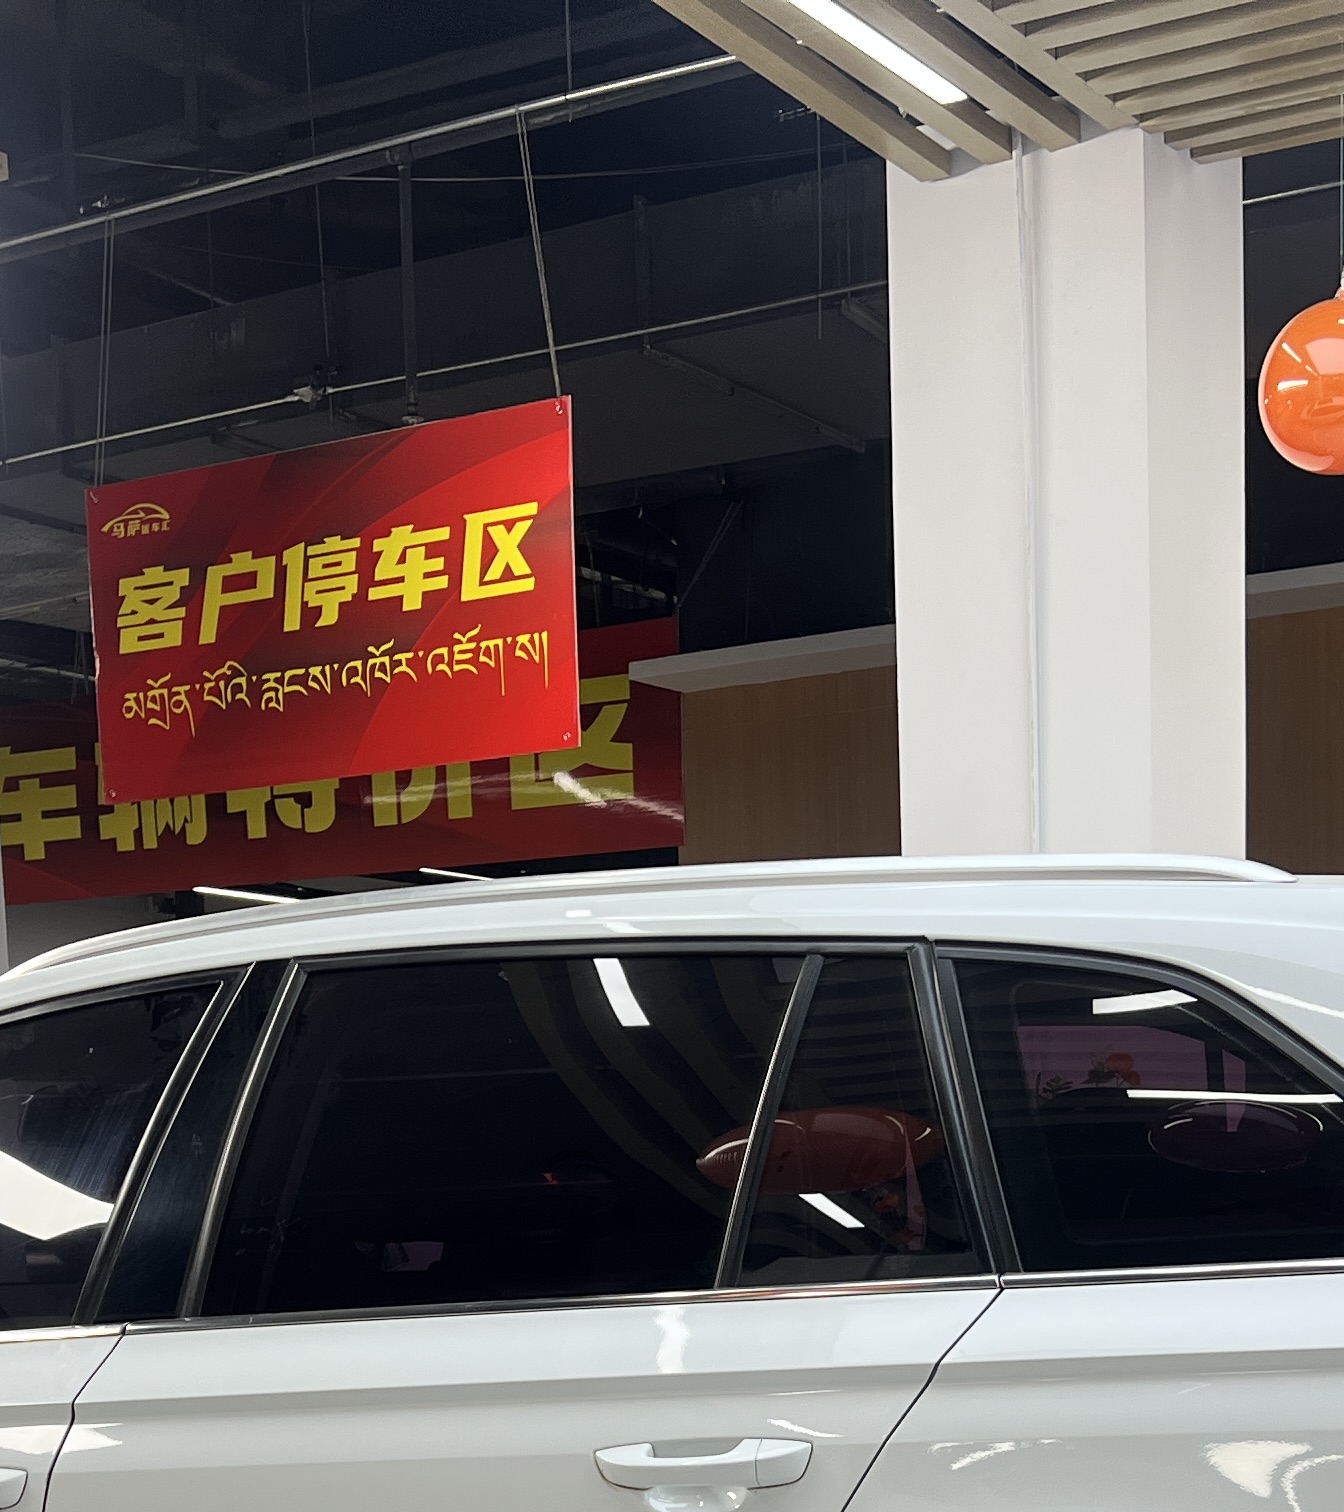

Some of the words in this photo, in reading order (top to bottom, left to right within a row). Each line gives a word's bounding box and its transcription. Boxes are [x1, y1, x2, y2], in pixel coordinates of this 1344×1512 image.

[116, 501, 539, 655] 客户停车区
